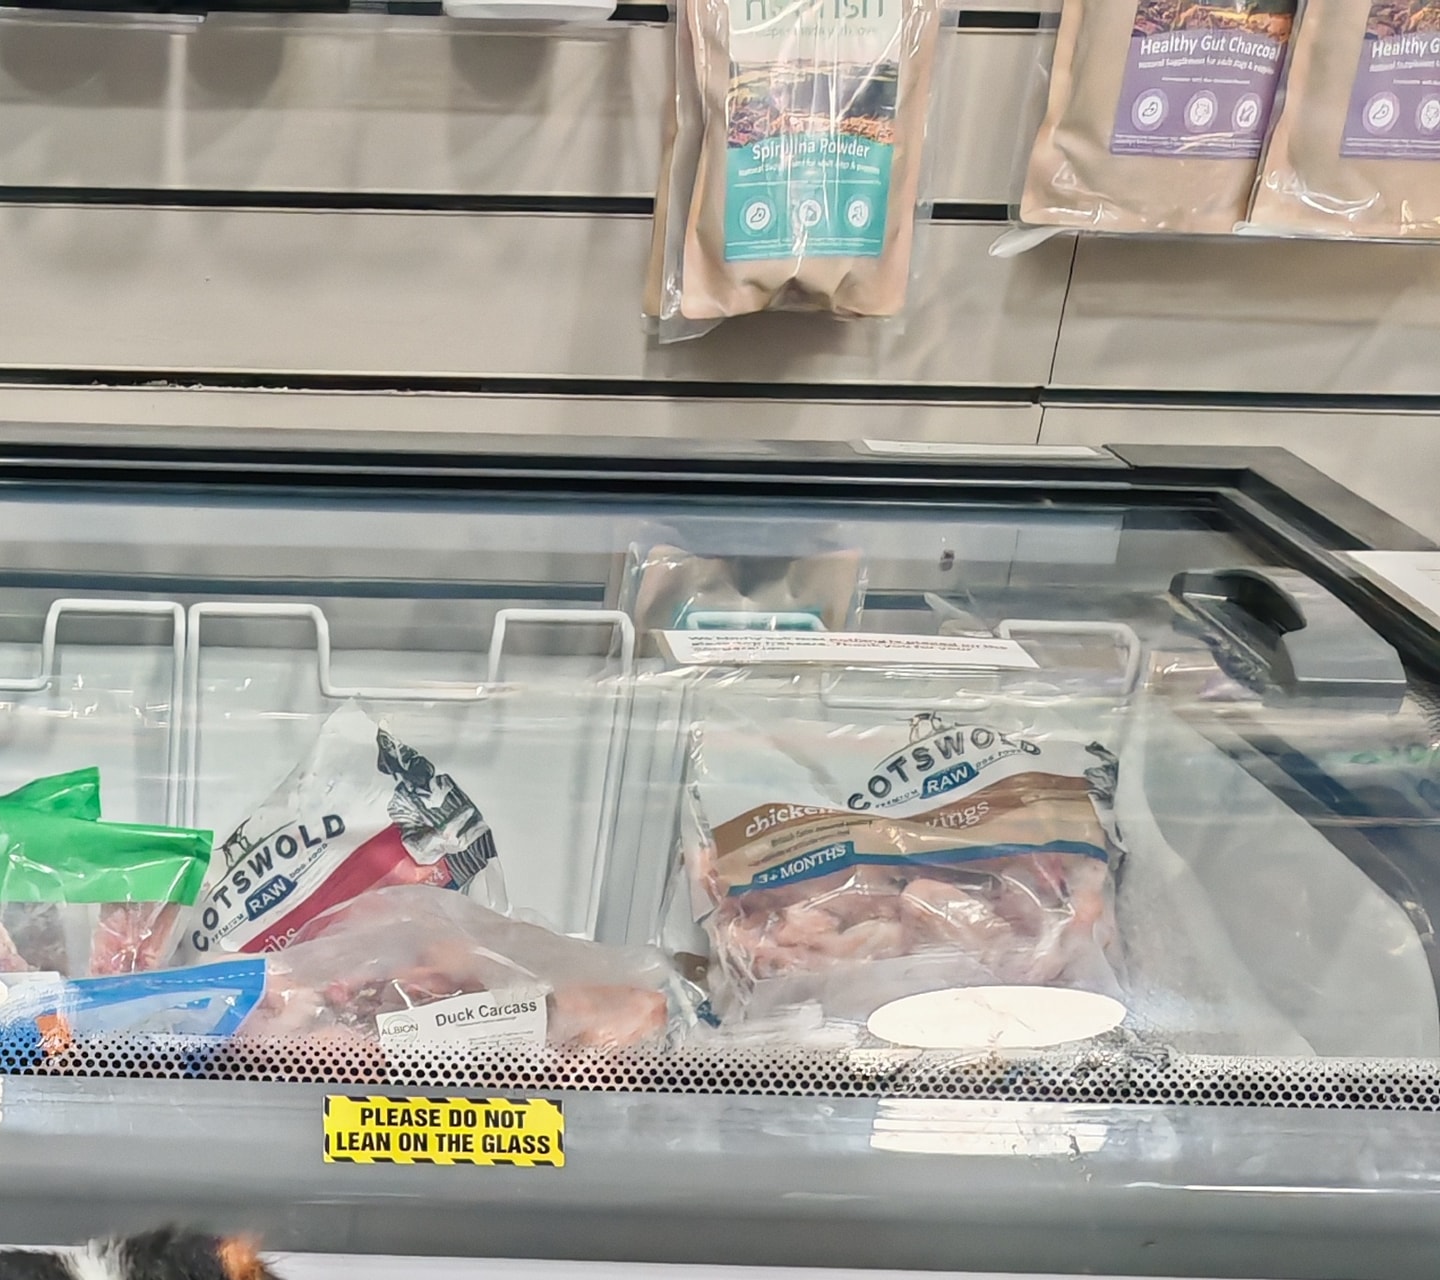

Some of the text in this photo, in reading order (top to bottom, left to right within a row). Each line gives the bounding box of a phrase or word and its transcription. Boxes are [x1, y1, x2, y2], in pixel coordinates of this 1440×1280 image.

[1140, 34, 1282, 62] Healthy Gut Charcoal
[1371, 37, 1430, 58] Healthy
[752, 138, 870, 161] Spirulina Powder
[847, 727, 1041, 811] COTSWOLD
[926, 765, 968, 795] RAW
[745, 804, 836, 839] chicken
[779, 843, 847, 880] MONTHS
[192, 814, 346, 952] COTSWOLD
[248, 878, 289, 914] RAW
[435, 1001, 537, 1027] Duck Carcass
[381, 1023, 419, 1036] ALBION
[360, 1107, 526, 1129] PLEASE DO NOT
[336, 1131, 550, 1155] LEAN ON THE GLASS
